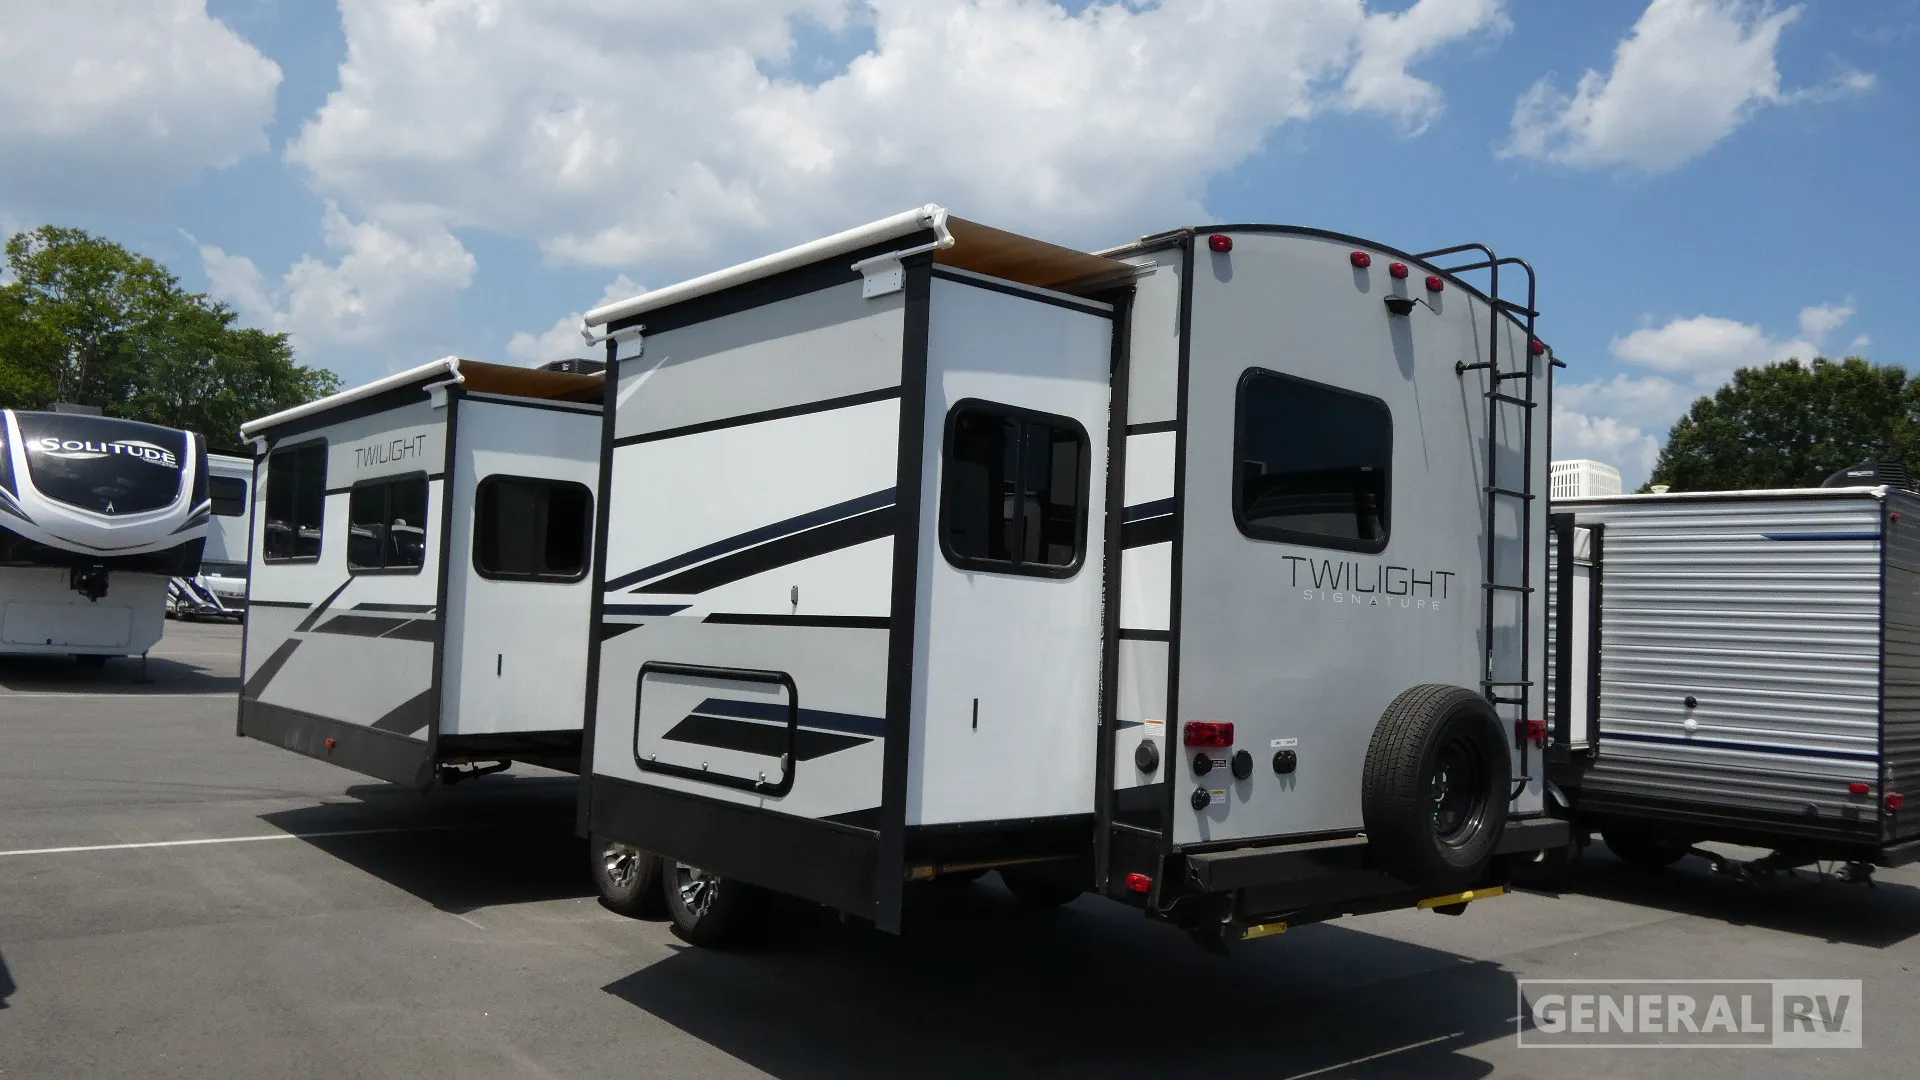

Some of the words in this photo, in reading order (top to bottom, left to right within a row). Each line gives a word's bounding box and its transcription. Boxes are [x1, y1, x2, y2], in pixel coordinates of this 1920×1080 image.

[41, 437, 177, 465] SOLITUDE
[354, 434, 427, 468] TWILIGHT
[1281, 555, 1456, 599] TWILIGHT
[1303, 589, 1441, 611] SIGNATURE
